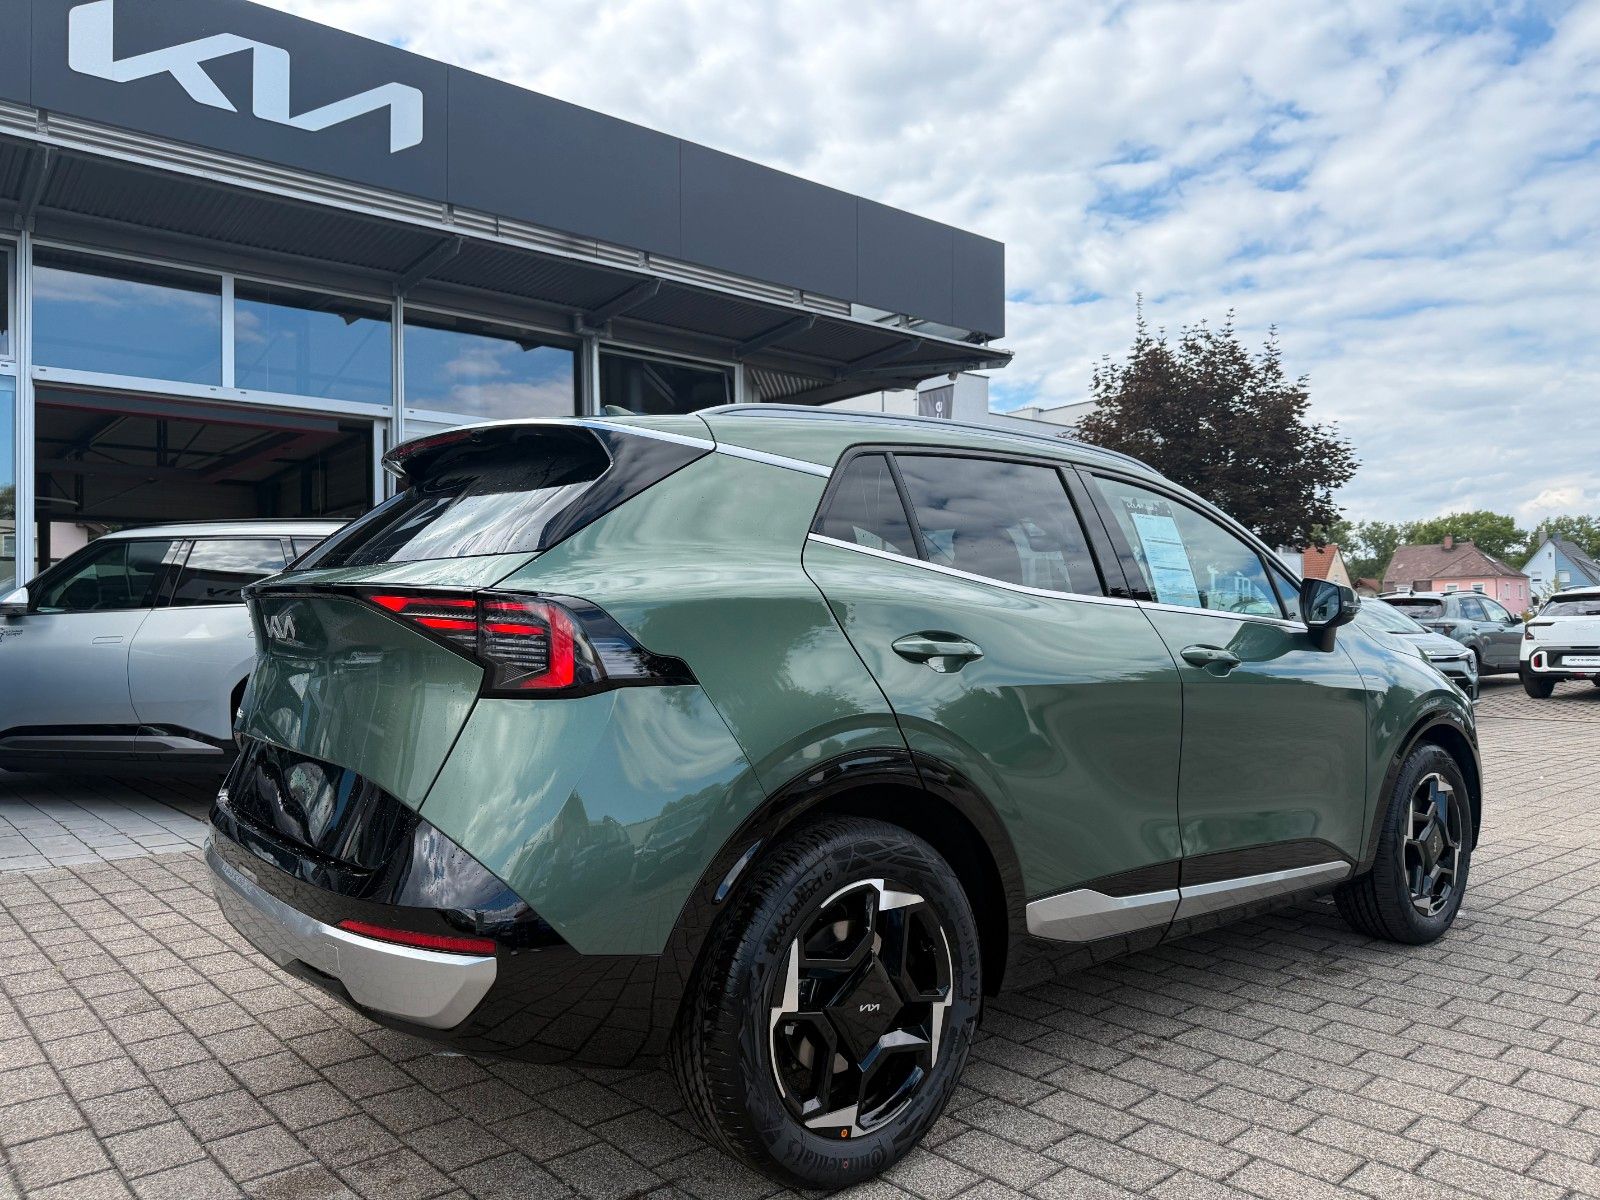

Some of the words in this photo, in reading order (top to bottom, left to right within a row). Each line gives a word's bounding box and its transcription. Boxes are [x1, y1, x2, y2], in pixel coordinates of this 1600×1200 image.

[69, 0, 423, 154] KIA
[263, 614, 296, 639] KIA
[859, 1003, 881, 1012] KIA
